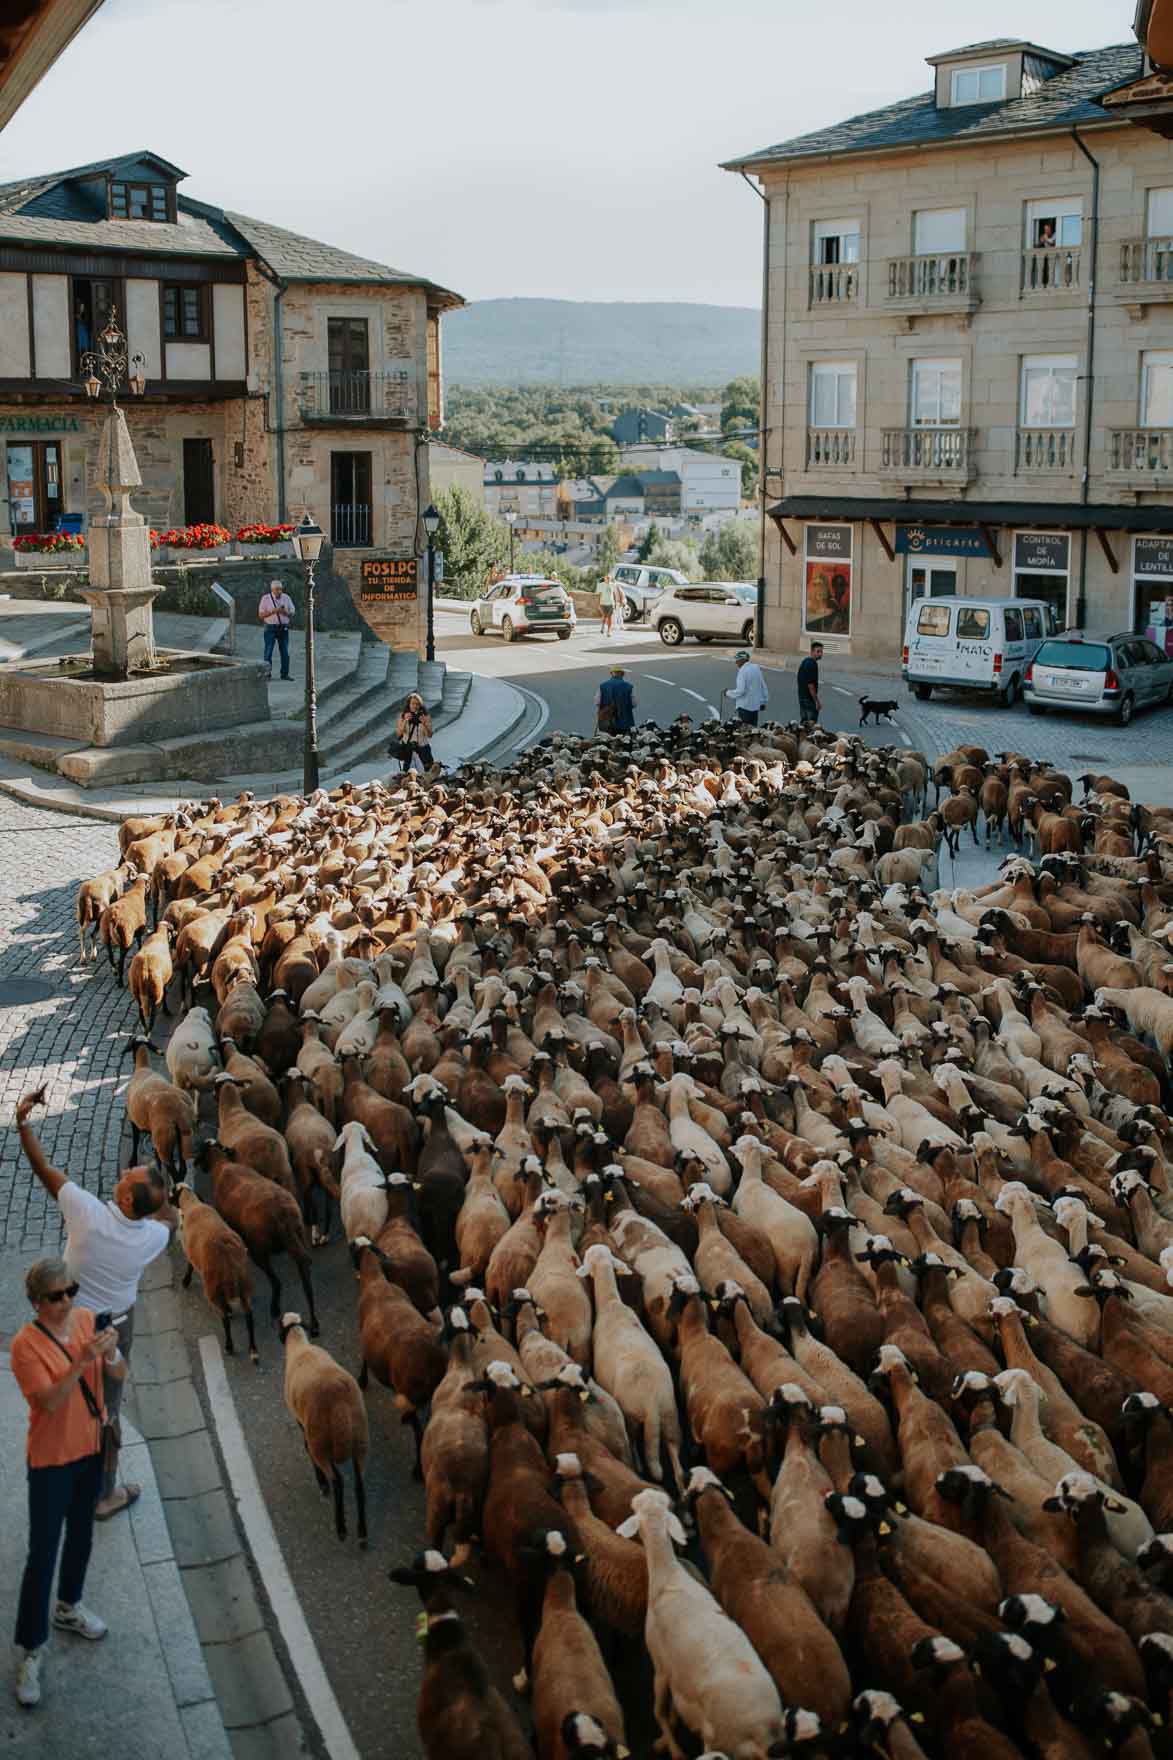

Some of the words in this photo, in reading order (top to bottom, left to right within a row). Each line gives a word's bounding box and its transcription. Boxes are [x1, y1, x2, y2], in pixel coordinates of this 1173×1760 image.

[0, 415, 79, 432] FARMACIA
[1023, 535, 1062, 545] CONTROL
[816, 541, 826, 550] DE
[828, 541, 841, 550] SOL
[1036, 546, 1048, 555] DE
[1158, 551, 1170, 561] DE
[367, 577, 378, 585] TU
[383, 576, 412, 585] TIENDA
[362, 592, 416, 601] INFORMATICA
